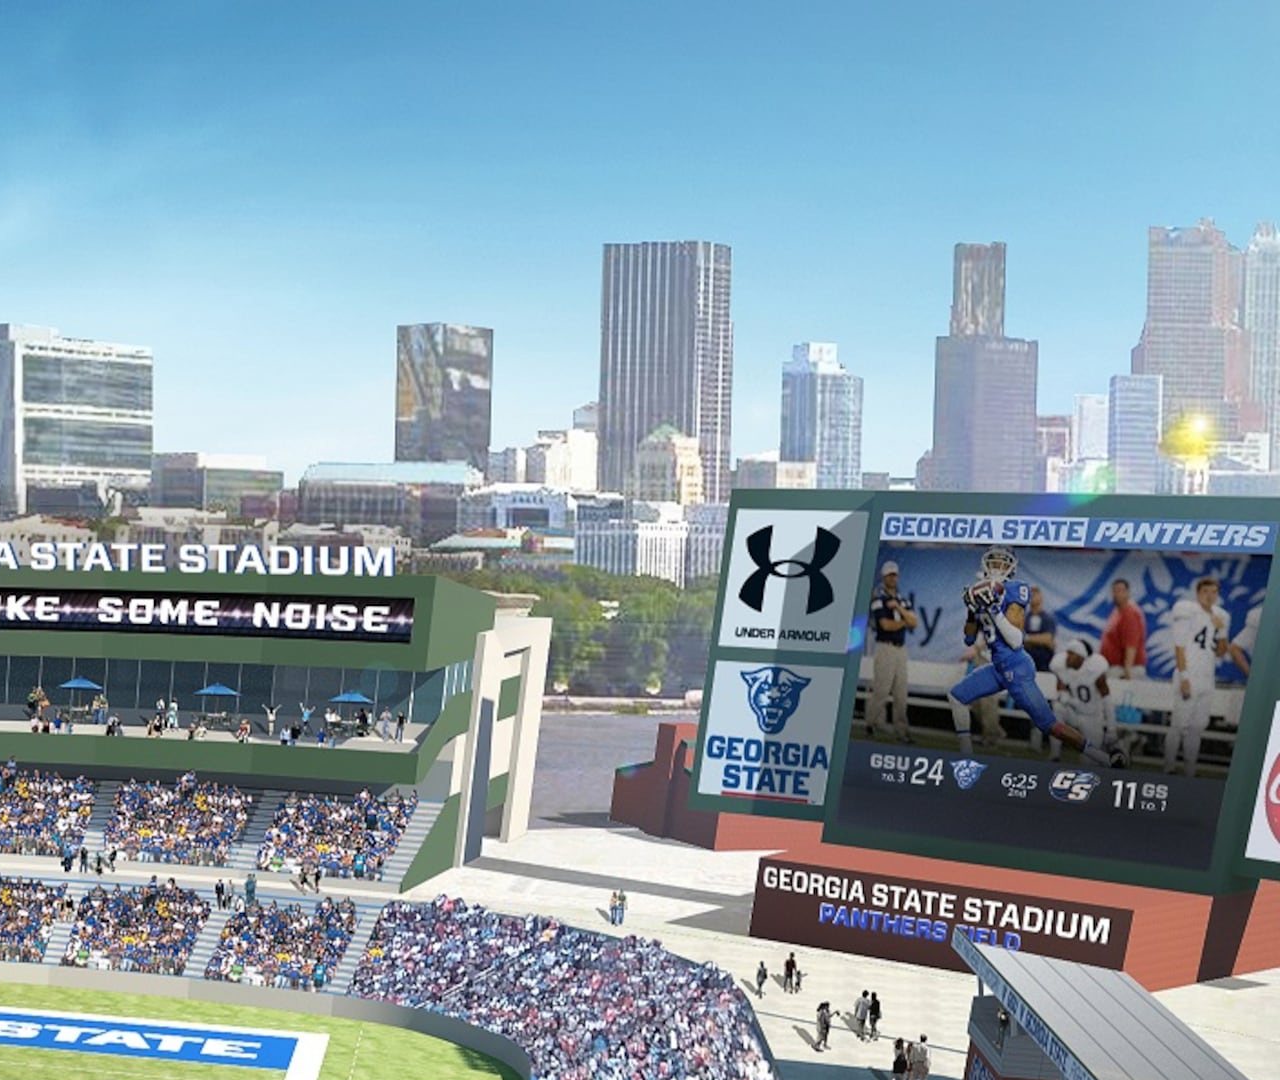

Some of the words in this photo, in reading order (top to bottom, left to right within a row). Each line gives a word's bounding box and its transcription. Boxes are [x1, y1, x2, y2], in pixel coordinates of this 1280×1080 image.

[884, 516, 994, 540] GEORGIA
[1002, 518, 1086, 543] STATE
[1093, 521, 1269, 548] PANTHERS
[30, 540, 168, 573] STATE
[179, 543, 395, 577] STADIUM
[97, 596, 220, 626] SOME
[252, 601, 391, 633] NOISE
[734, 626, 775, 640] UNDER
[778, 627, 830, 642] ARMOUR
[706, 735, 829, 769] GEORGIA
[722, 764, 810, 796] STATE
[870, 753, 910, 771] GSU
[910, 757, 944, 786] 24
[1001, 772, 1038, 790] 6:25
[1112, 780, 1137, 810] 11
[1142, 782, 1168, 799] GS
[763, 866, 865, 904] GEORGIA
[871, 883, 957, 920] STATE
[962, 898, 1111, 945] STADIUM
[818, 902, 948, 943] PANTHERS
